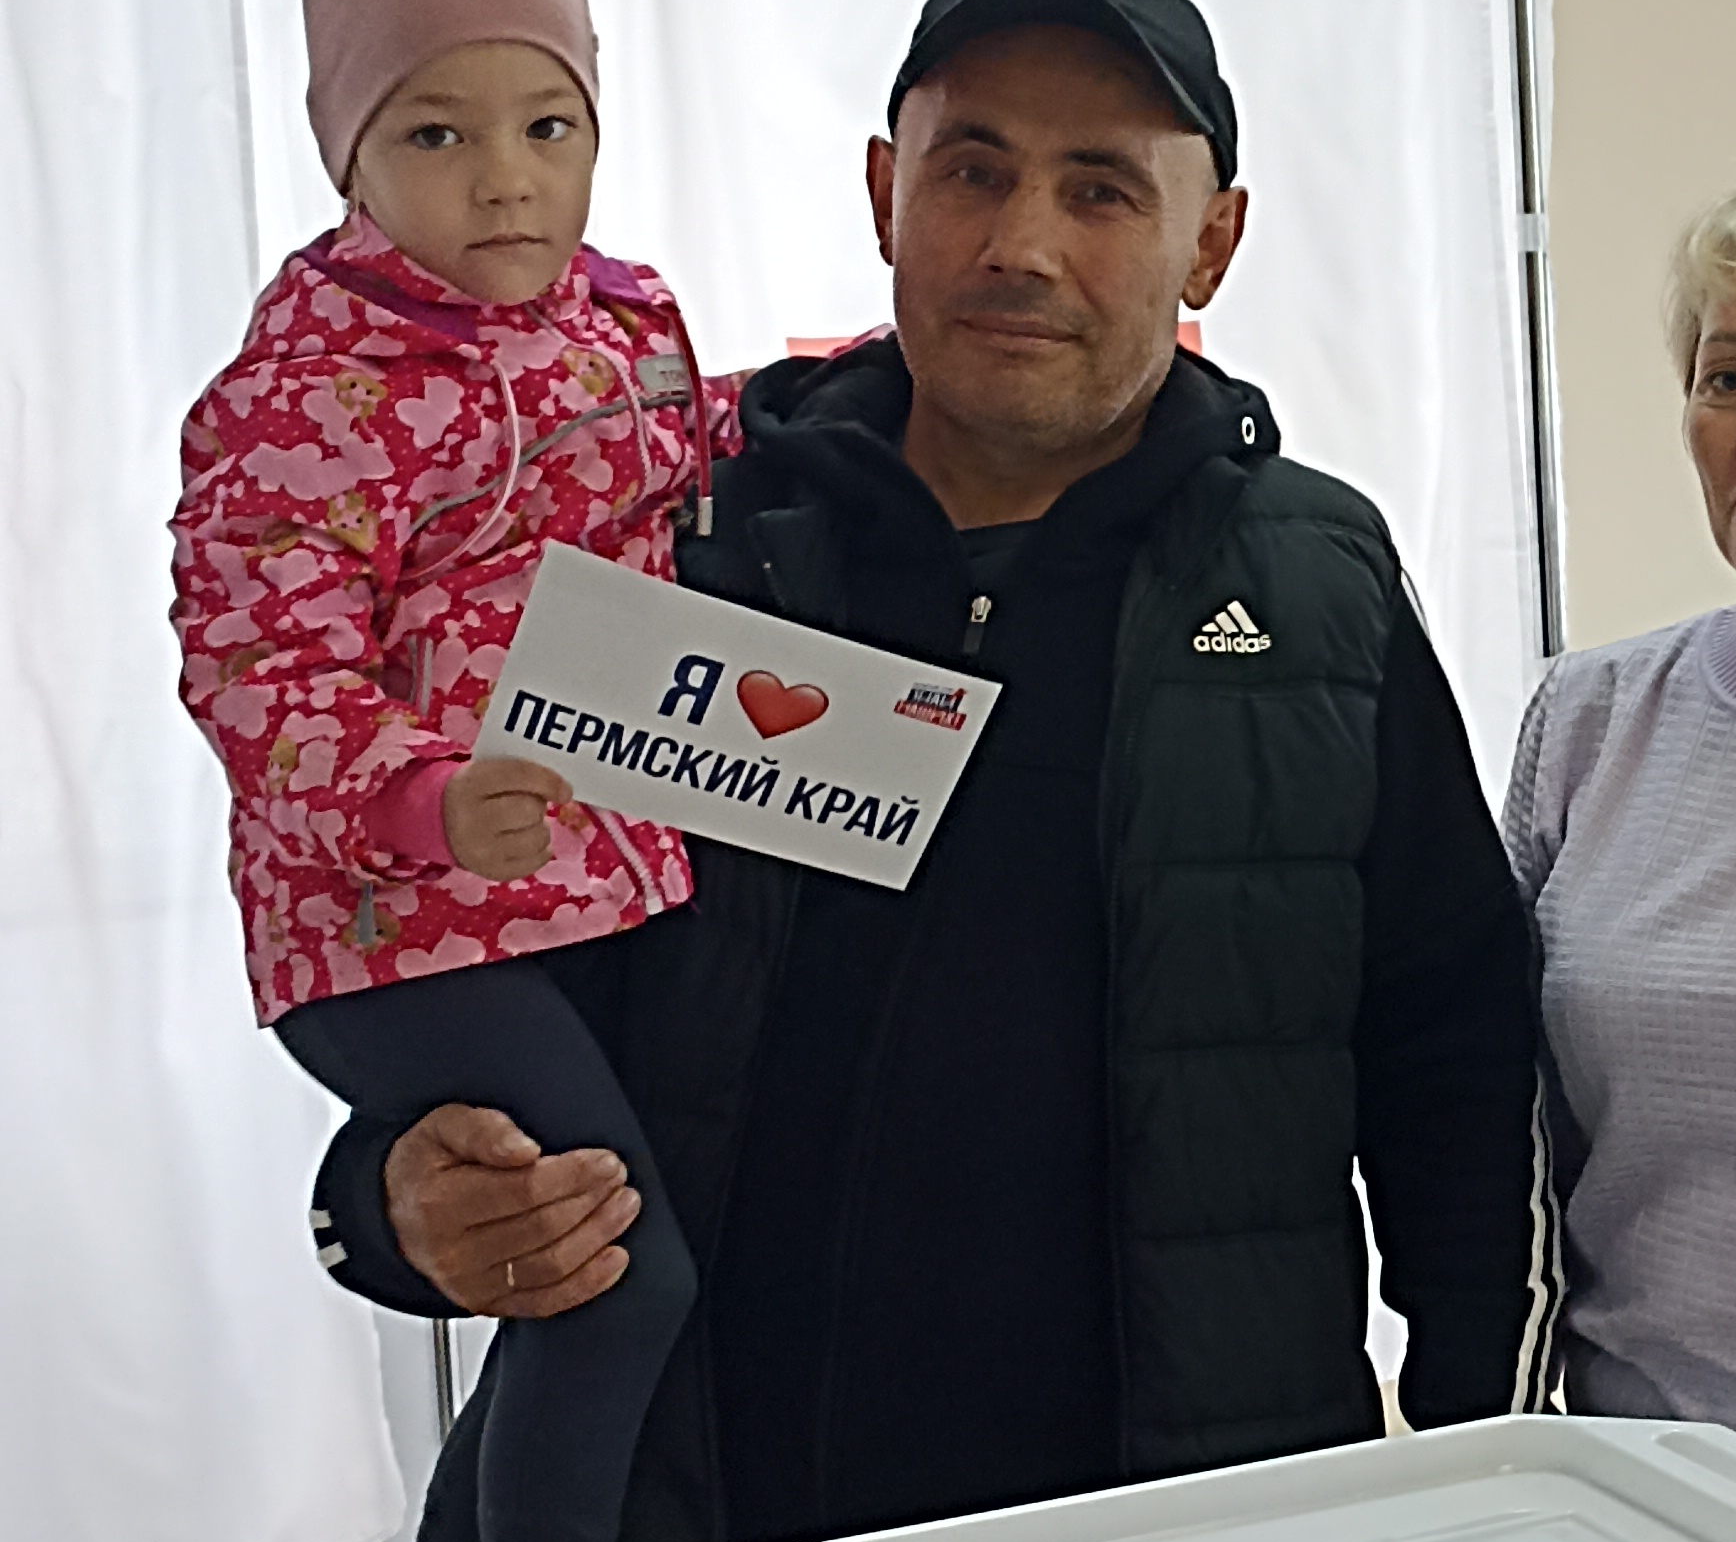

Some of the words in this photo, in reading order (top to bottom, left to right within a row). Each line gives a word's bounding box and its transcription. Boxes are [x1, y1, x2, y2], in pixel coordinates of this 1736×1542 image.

[1193, 632, 1272, 653] adidas
[657, 653, 725, 725] Я
[503, 689, 782, 808] ПЕРМСКИЙ
[784, 777, 920, 846] КРАЙ
